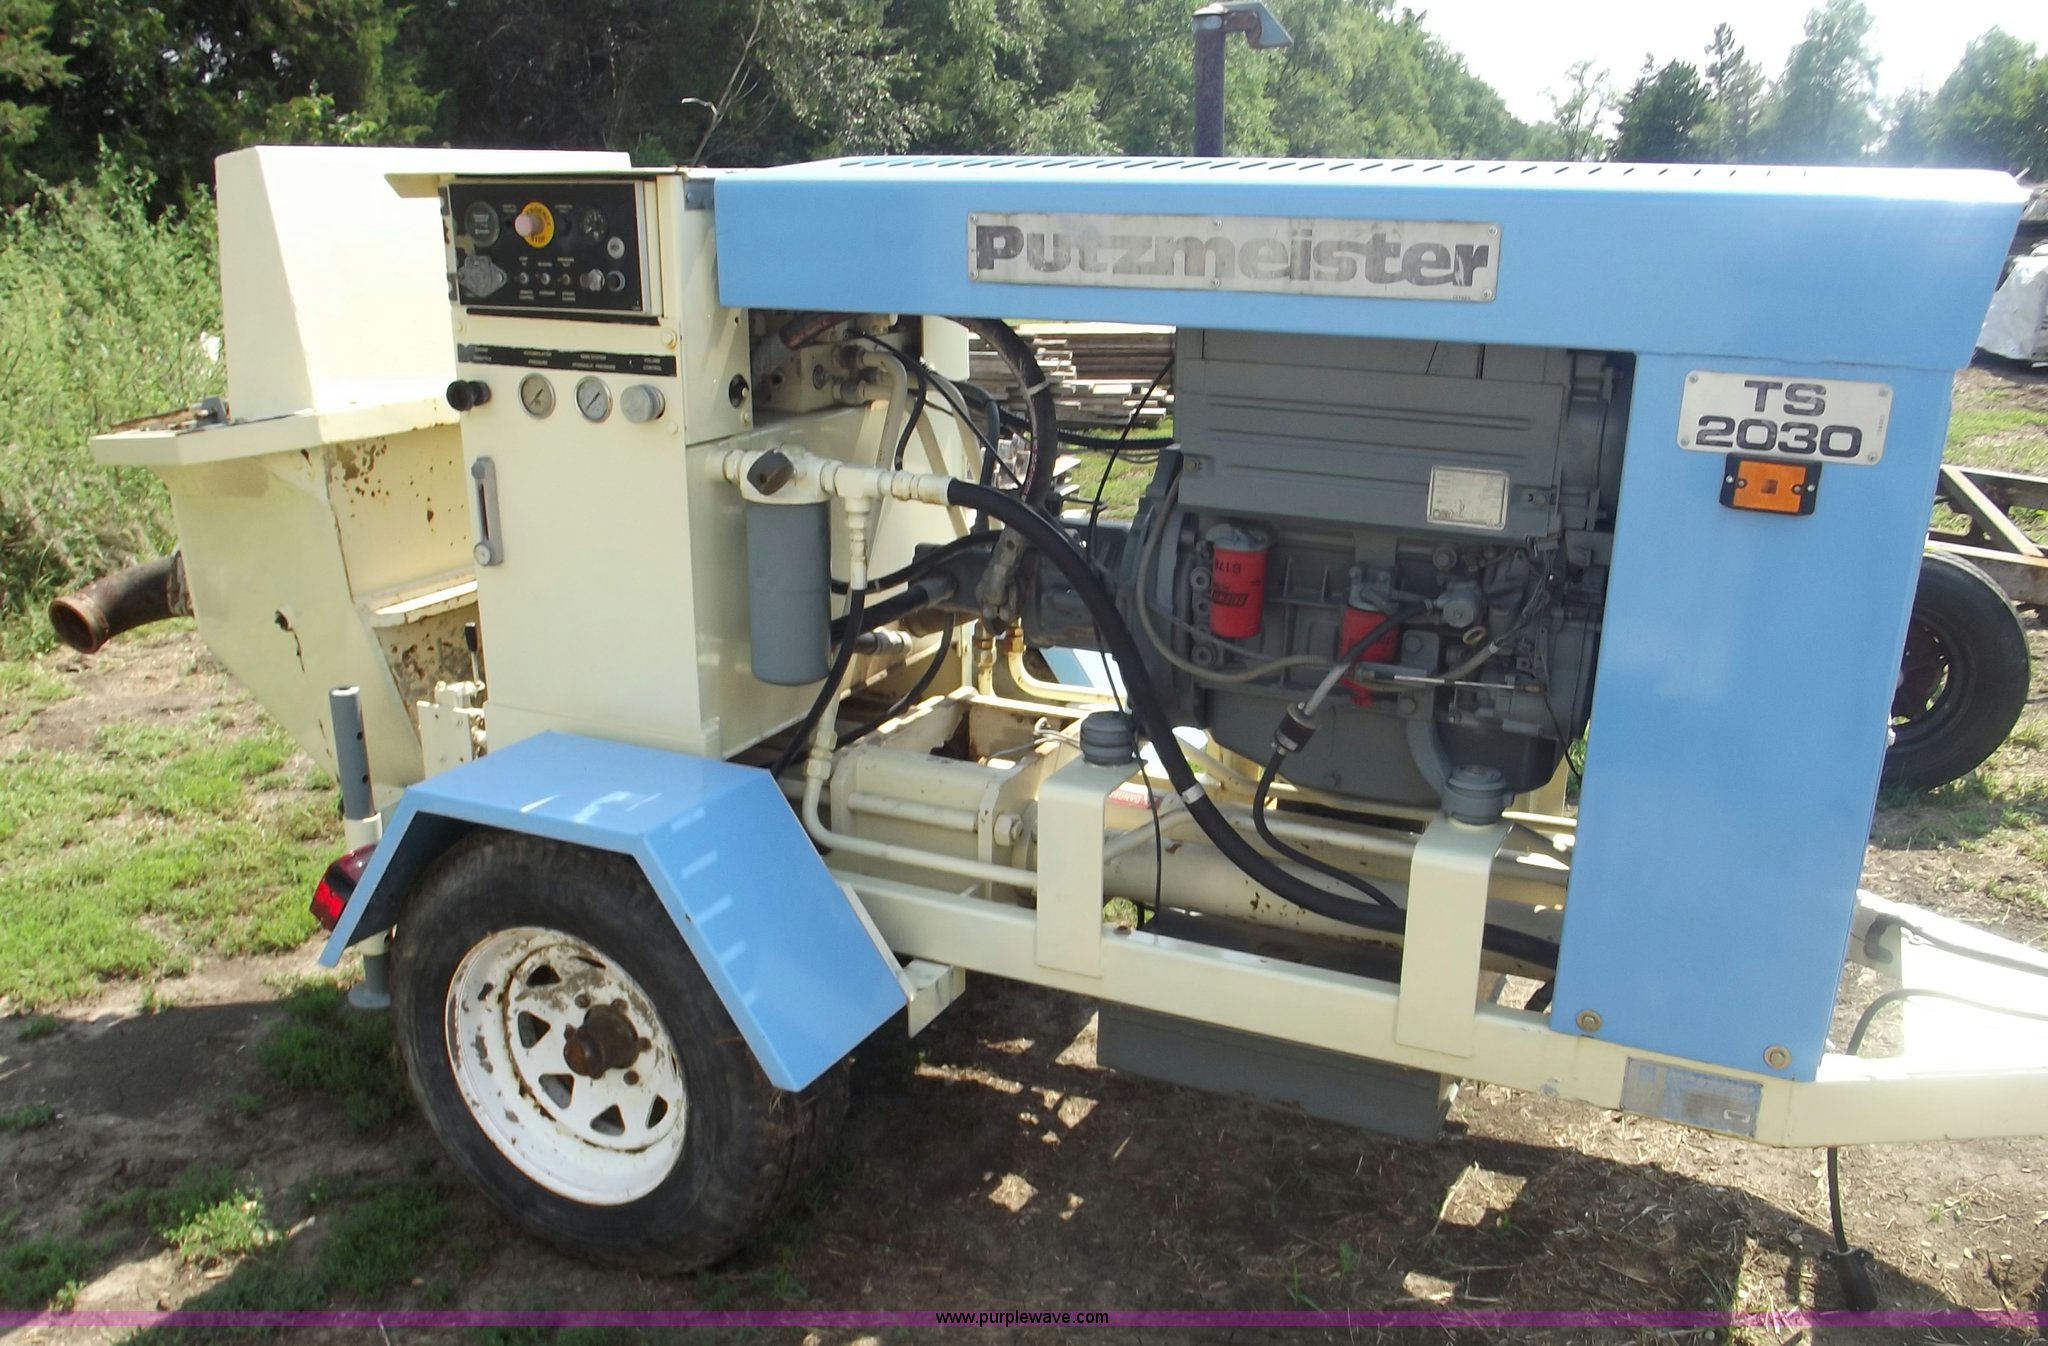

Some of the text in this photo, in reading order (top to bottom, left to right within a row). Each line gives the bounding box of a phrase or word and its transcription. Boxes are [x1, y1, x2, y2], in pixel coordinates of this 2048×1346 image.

[975, 223, 1489, 288] Putzmeister
[1744, 380, 1827, 417] TS
[1695, 415, 1863, 458] 2030
